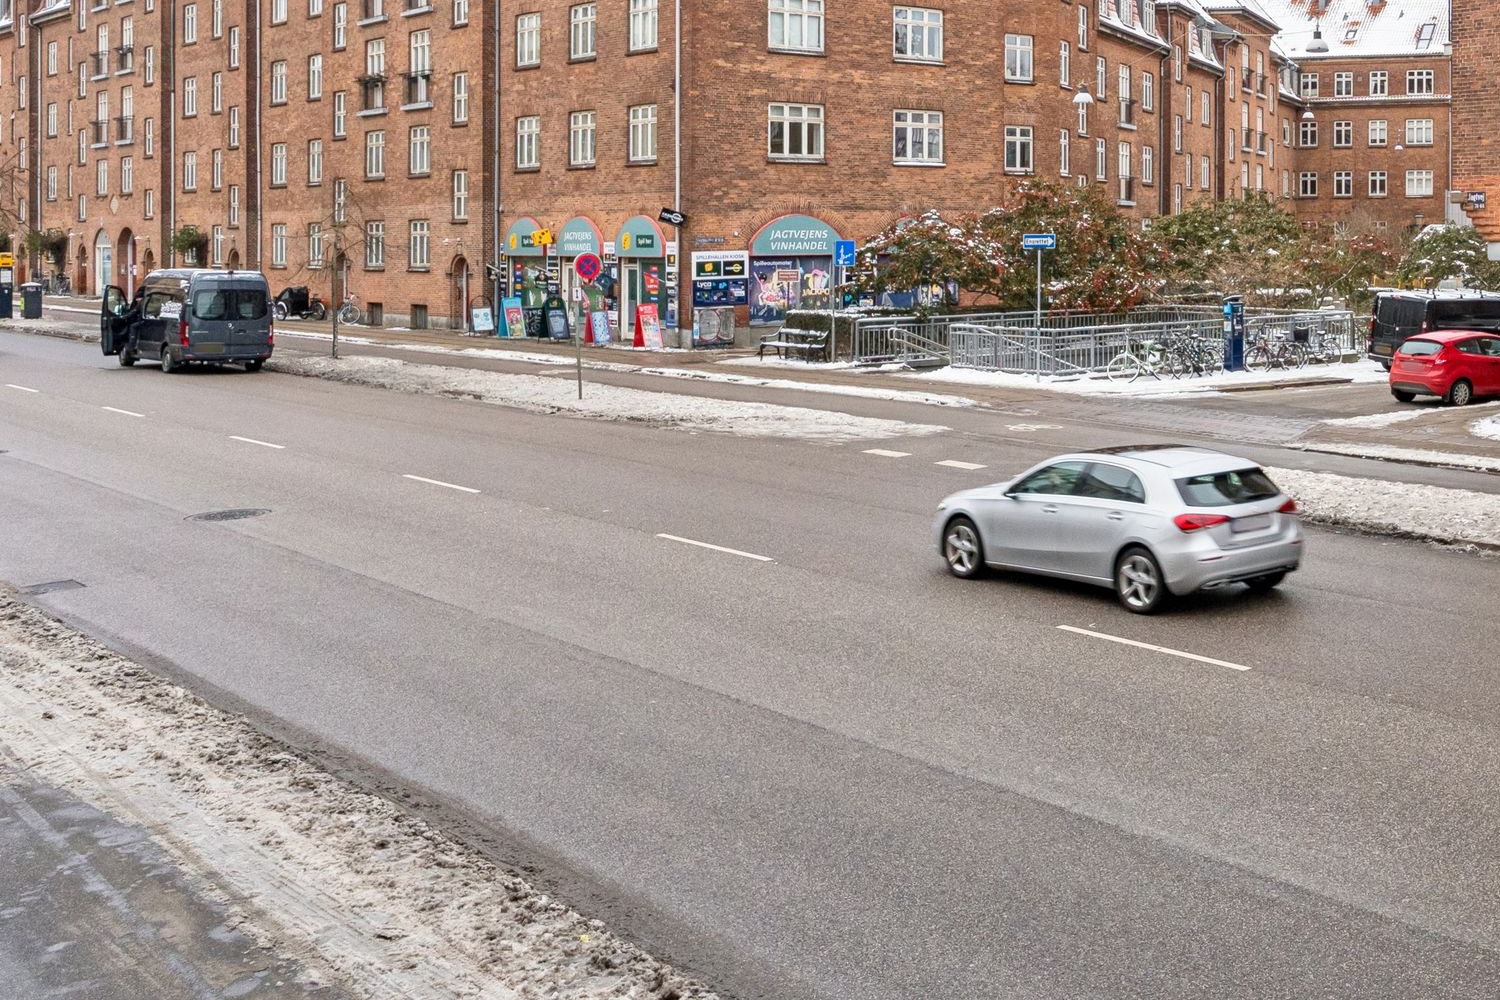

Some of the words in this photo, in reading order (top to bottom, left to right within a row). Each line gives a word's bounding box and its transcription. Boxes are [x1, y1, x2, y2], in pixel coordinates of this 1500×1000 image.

[563, 231, 592, 241] JAGTVEJENS
[769, 230, 828, 240] JAGTVEJENS
[563, 243, 592, 251] VINHANDEL
[770, 241, 828, 250] VINHANDEL
